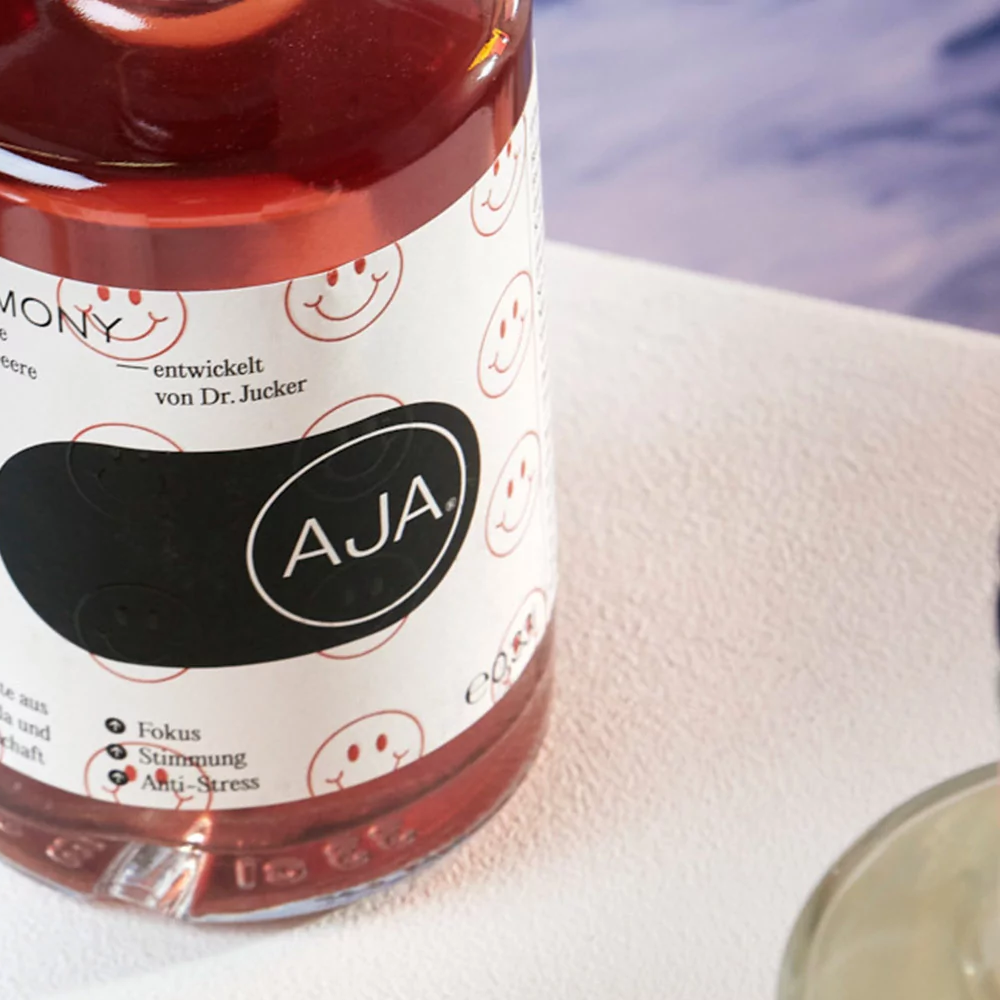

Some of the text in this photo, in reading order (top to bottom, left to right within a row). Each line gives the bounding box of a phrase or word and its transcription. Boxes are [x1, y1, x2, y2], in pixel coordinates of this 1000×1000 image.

[153, 356, 265, 378] entwickelt
[155, 379, 308, 406] von Dr. Jucker
[19, 693, 49, 716] aus
[18, 718, 51, 743] und
[138, 721, 202, 742] Fokus
[138, 747, 247, 769] Stimmung
[141, 774, 260, 793] Anti-Stress
